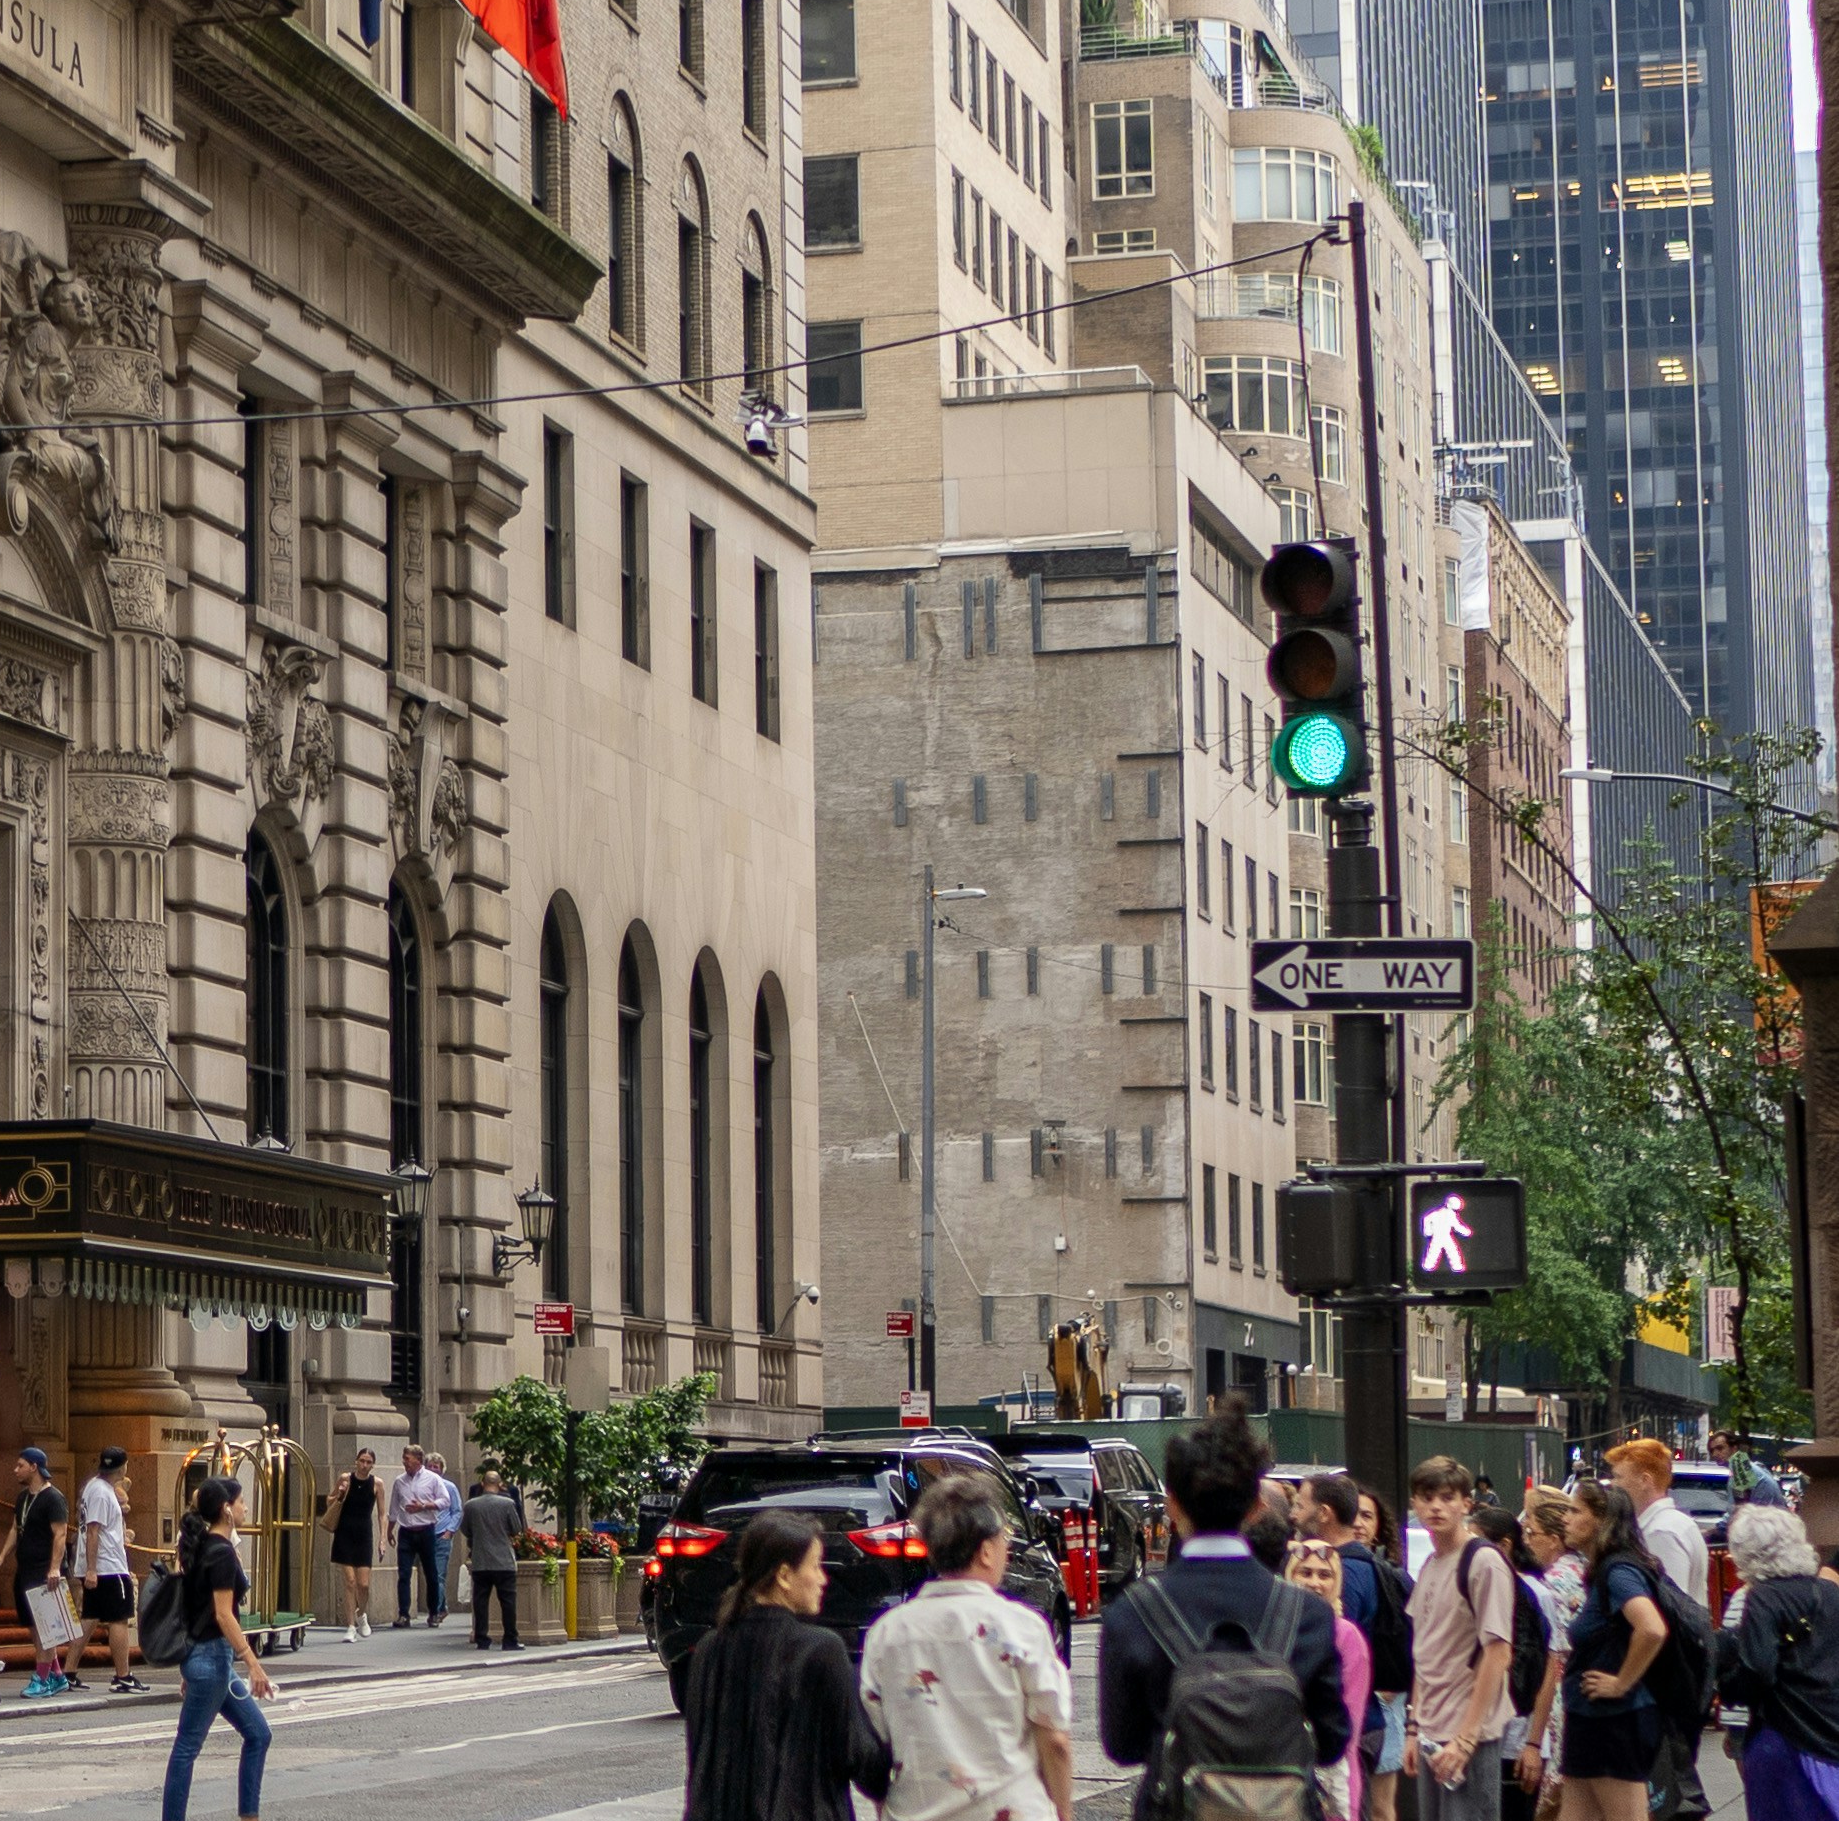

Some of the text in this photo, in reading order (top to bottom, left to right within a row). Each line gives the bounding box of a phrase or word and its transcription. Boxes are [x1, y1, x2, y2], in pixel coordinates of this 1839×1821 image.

[1279, 961, 1453, 990] ONE WAY
[178, 1186, 312, 1242] THE PENINSULA
